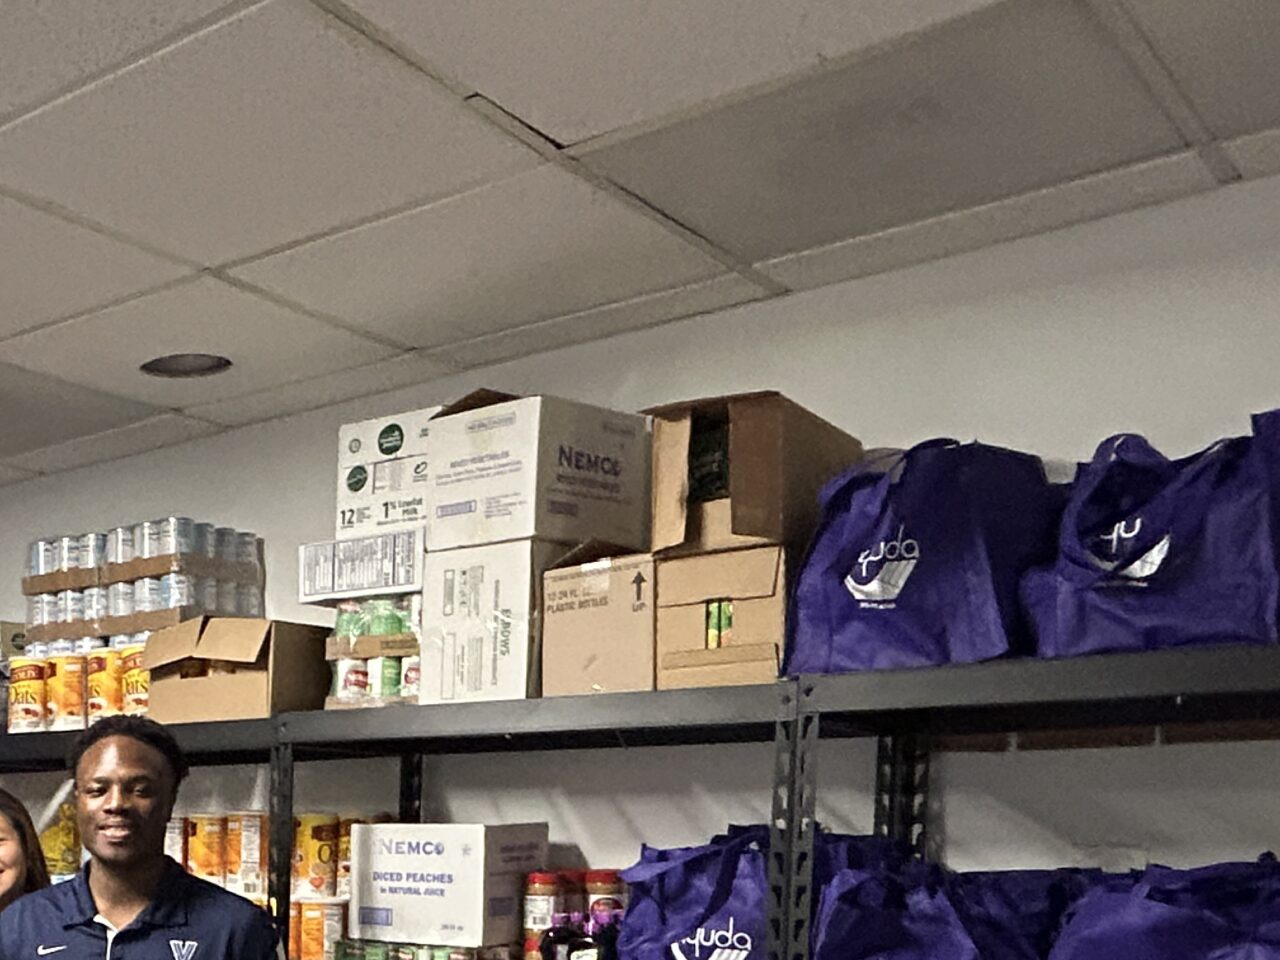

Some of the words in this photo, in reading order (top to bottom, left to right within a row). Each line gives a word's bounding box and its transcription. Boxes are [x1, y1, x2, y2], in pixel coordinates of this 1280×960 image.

[340, 508, 355, 525] 12
[378, 837, 445, 856] NEMCO
[372, 871, 403, 883] DICED
[405, 871, 454, 884] PEACHES
